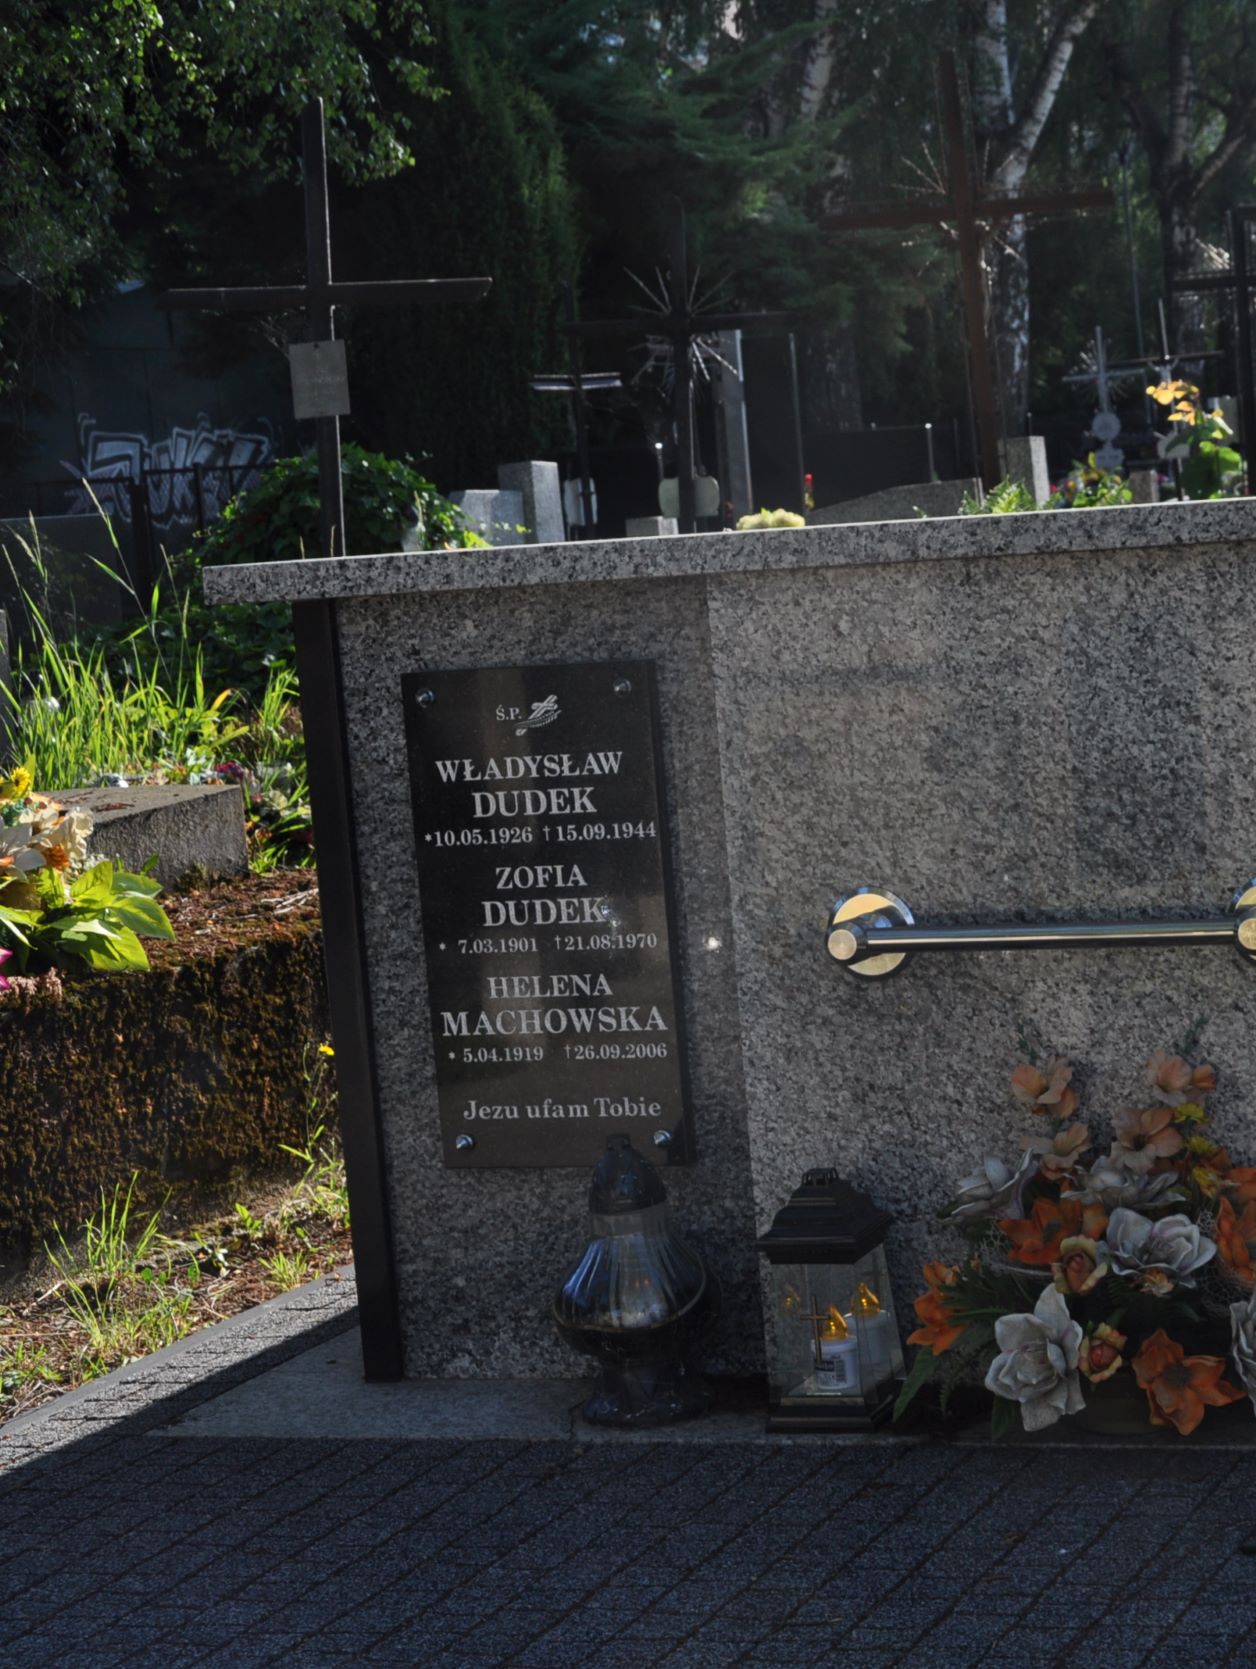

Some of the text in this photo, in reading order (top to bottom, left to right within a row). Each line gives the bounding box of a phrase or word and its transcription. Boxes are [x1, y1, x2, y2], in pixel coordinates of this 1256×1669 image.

[435, 751, 624, 783] WŁADYSŁAW
[471, 787, 598, 818] DUDEK
[495, 864, 588, 890] ZOFIA
[481, 897, 607, 927] DUDEK
[487, 973, 613, 999] HELENA
[440, 1005, 669, 1037] MACHOWSKA
[463, 1096, 662, 1121] Jezu ufam Tobie
